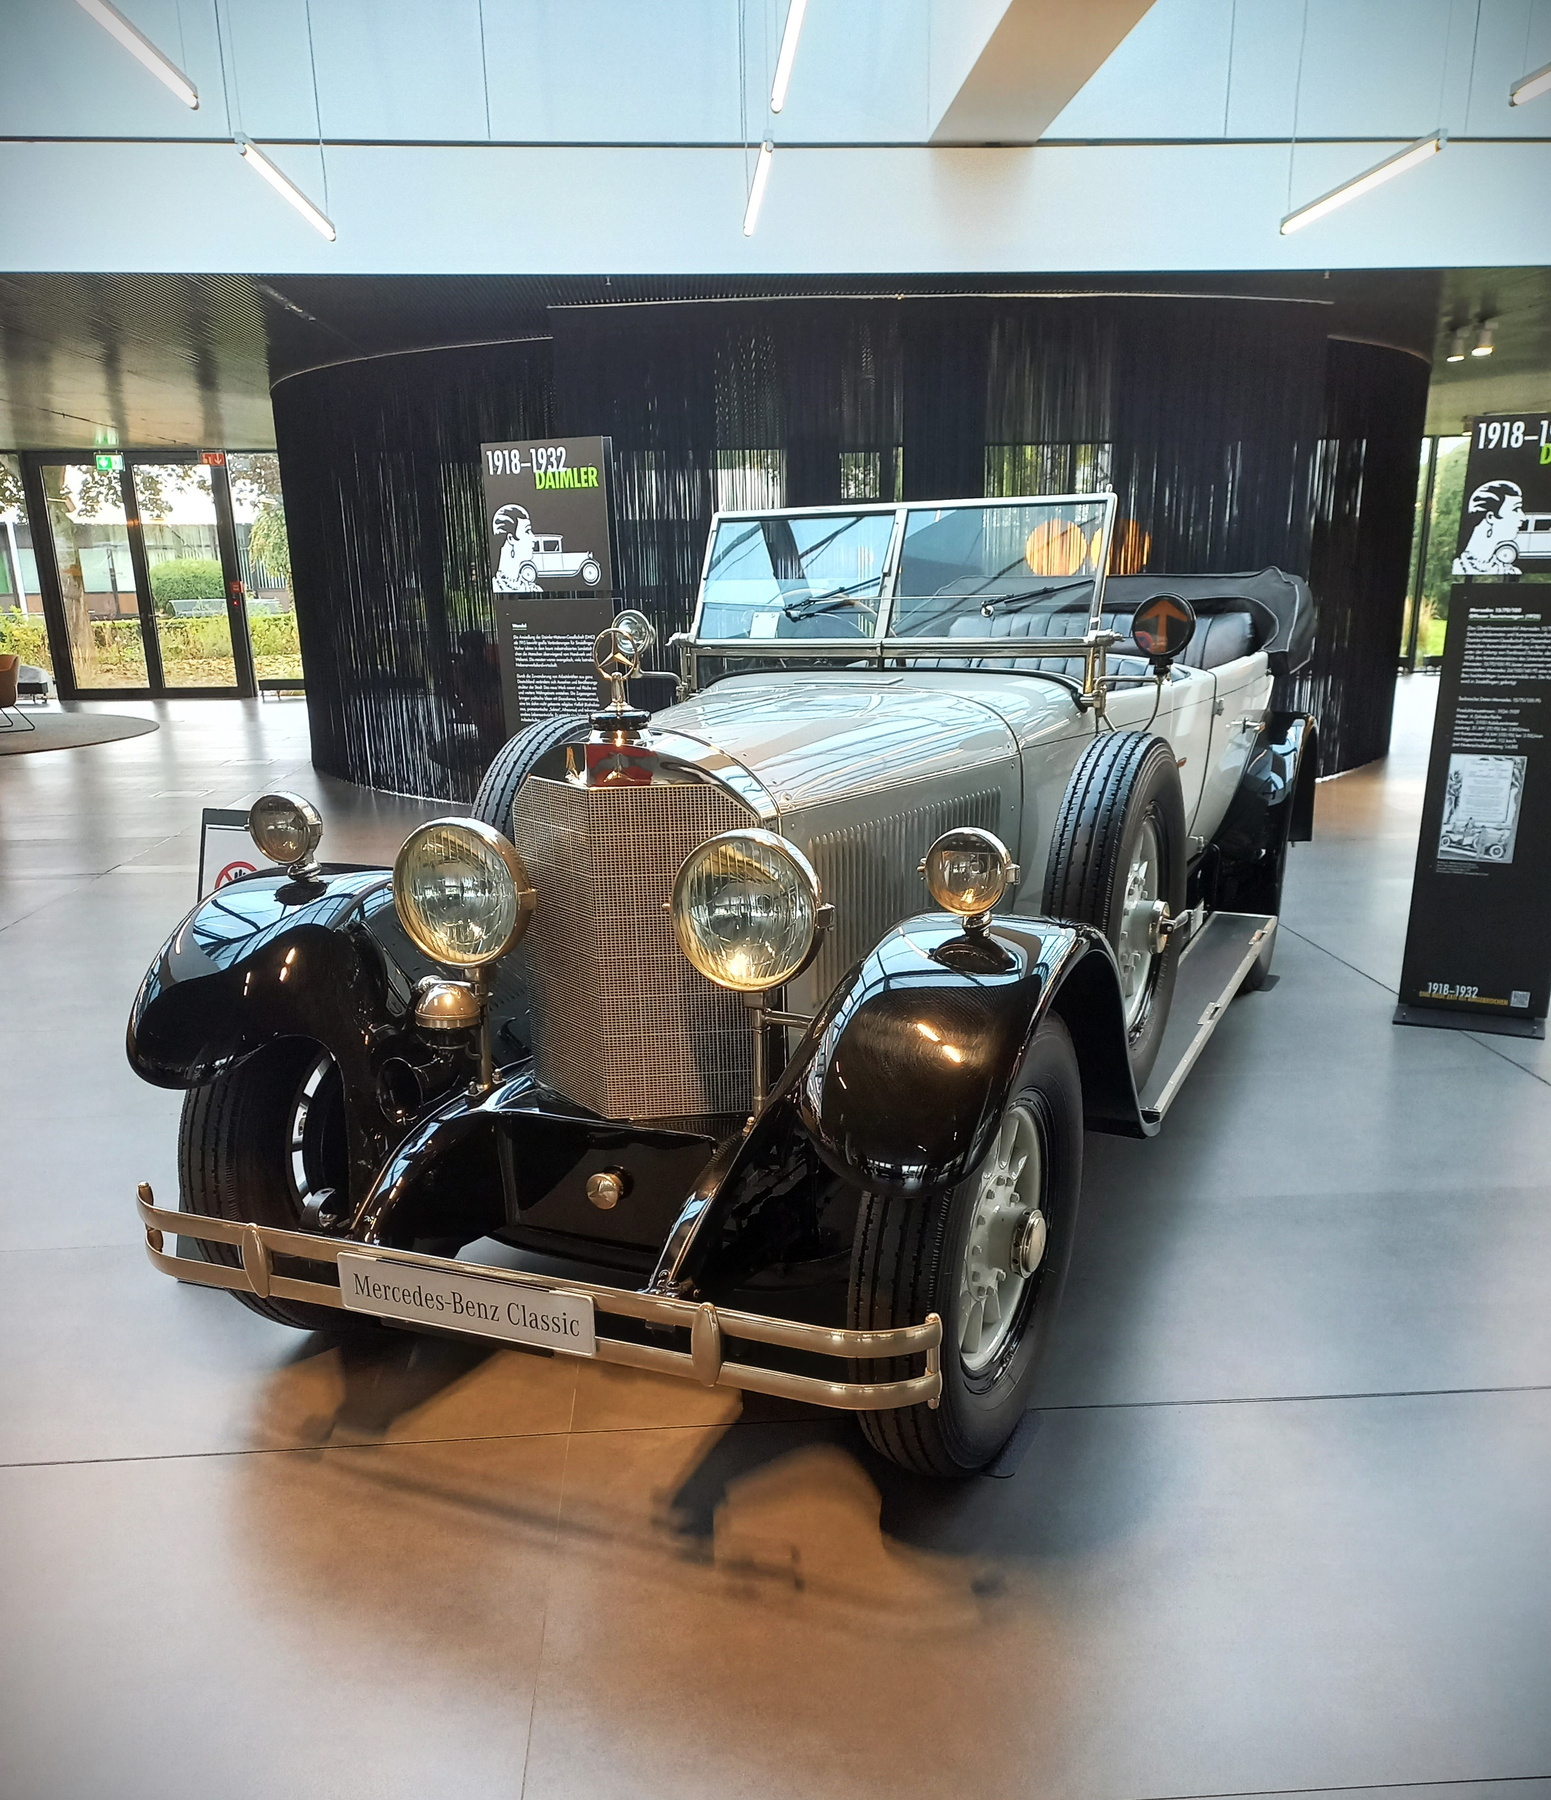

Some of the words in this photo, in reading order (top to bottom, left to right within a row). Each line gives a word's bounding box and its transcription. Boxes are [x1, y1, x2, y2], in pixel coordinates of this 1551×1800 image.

[535, 467, 598, 489] DAIMLER
[353, 1273, 500, 1322] Mercedes-Benz
[507, 1302, 580, 1337] Classic
